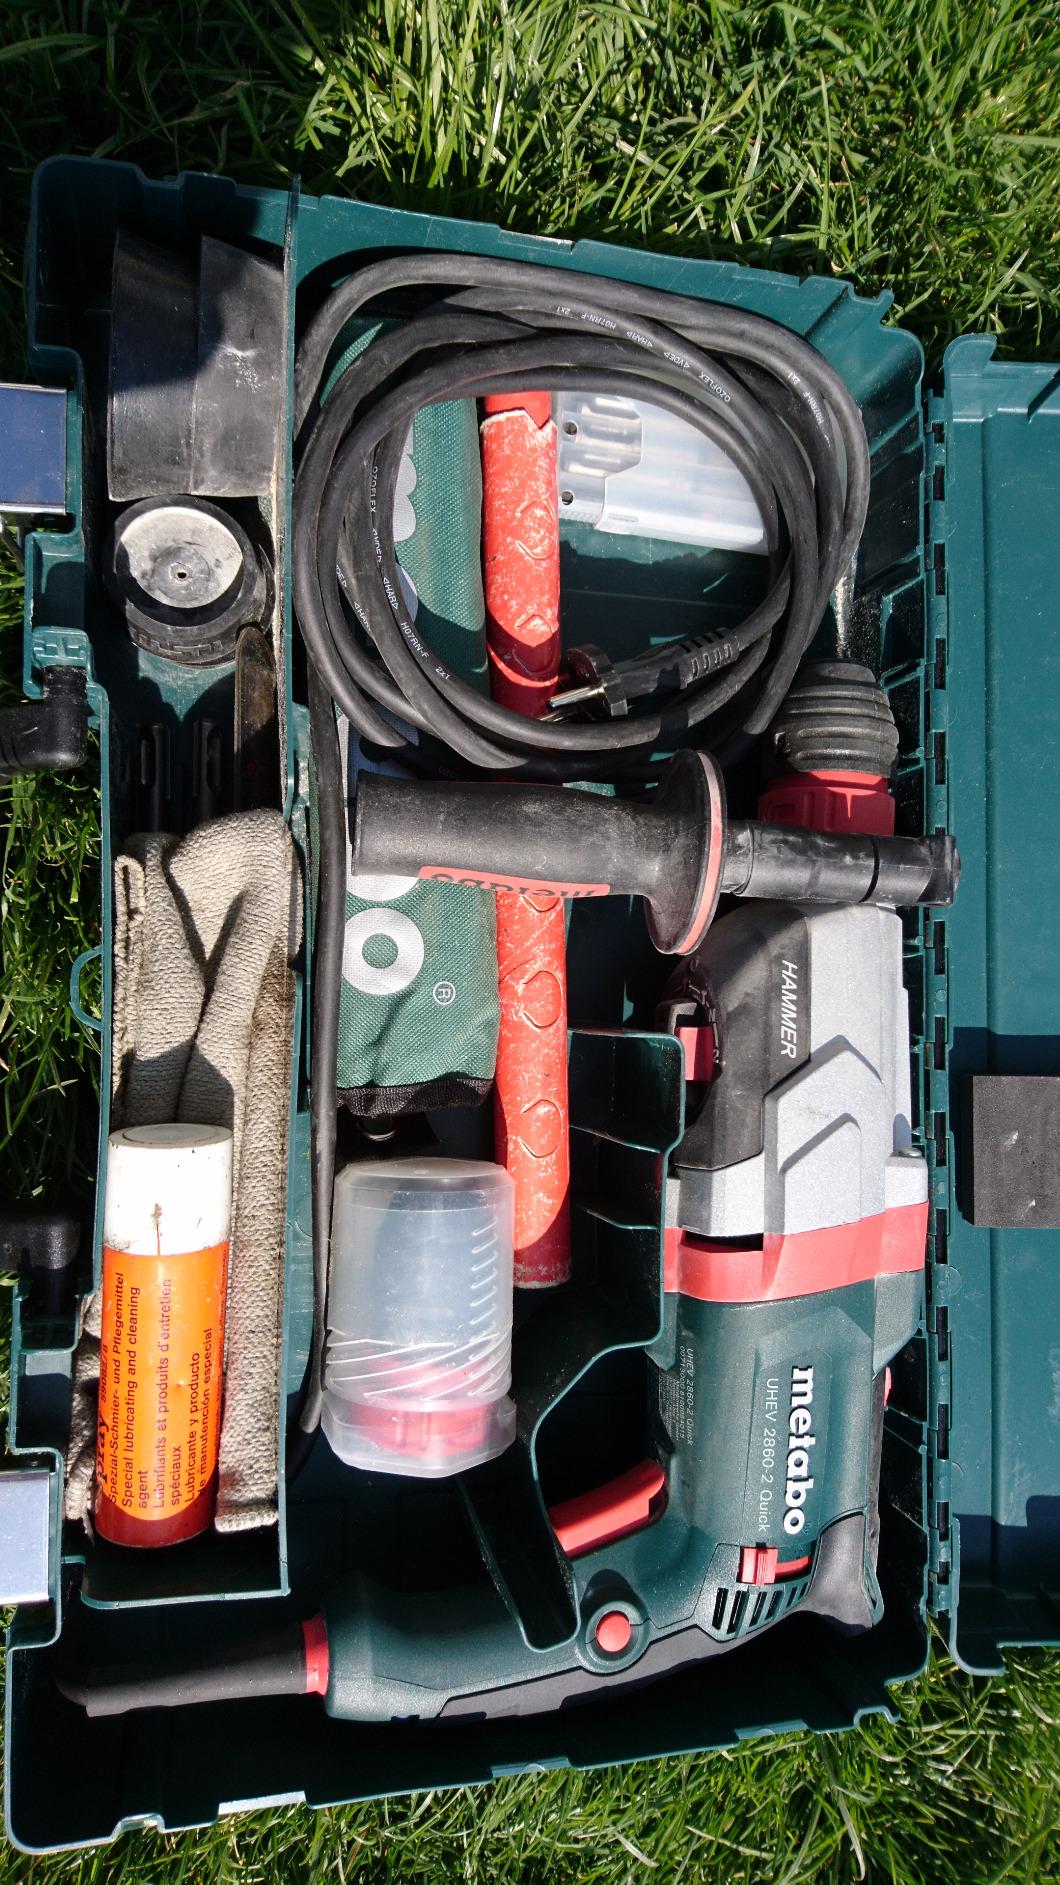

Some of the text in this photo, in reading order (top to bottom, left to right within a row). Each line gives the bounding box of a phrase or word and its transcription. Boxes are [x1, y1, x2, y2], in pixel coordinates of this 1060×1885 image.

[699, 371, 731, 402] OZOFLEX
[400, 621, 429, 659] H07RN-F
[781, 960, 798, 1059] HAMMER
[108, 1272, 124, 1503] Spezial-Schmier- und Pflegemittel
[156, 1357, 169, 1414] produits
[202, 1327, 215, 1384] especial
[121, 1287, 141, 1508] Special lubricating and cleaning
[157, 1418, 167, 1432] et
[185, 1352, 201, 1503] Lubricante y producto
[153, 1436, 167, 1508] Lubrifiants
[168, 1445, 182, 1506] spéciaux
[758, 1378, 779, 1532] UHEV 2860-2 Quick
[783, 1365, 816, 1535] metabo
[138, 1470, 149, 1509] agent
